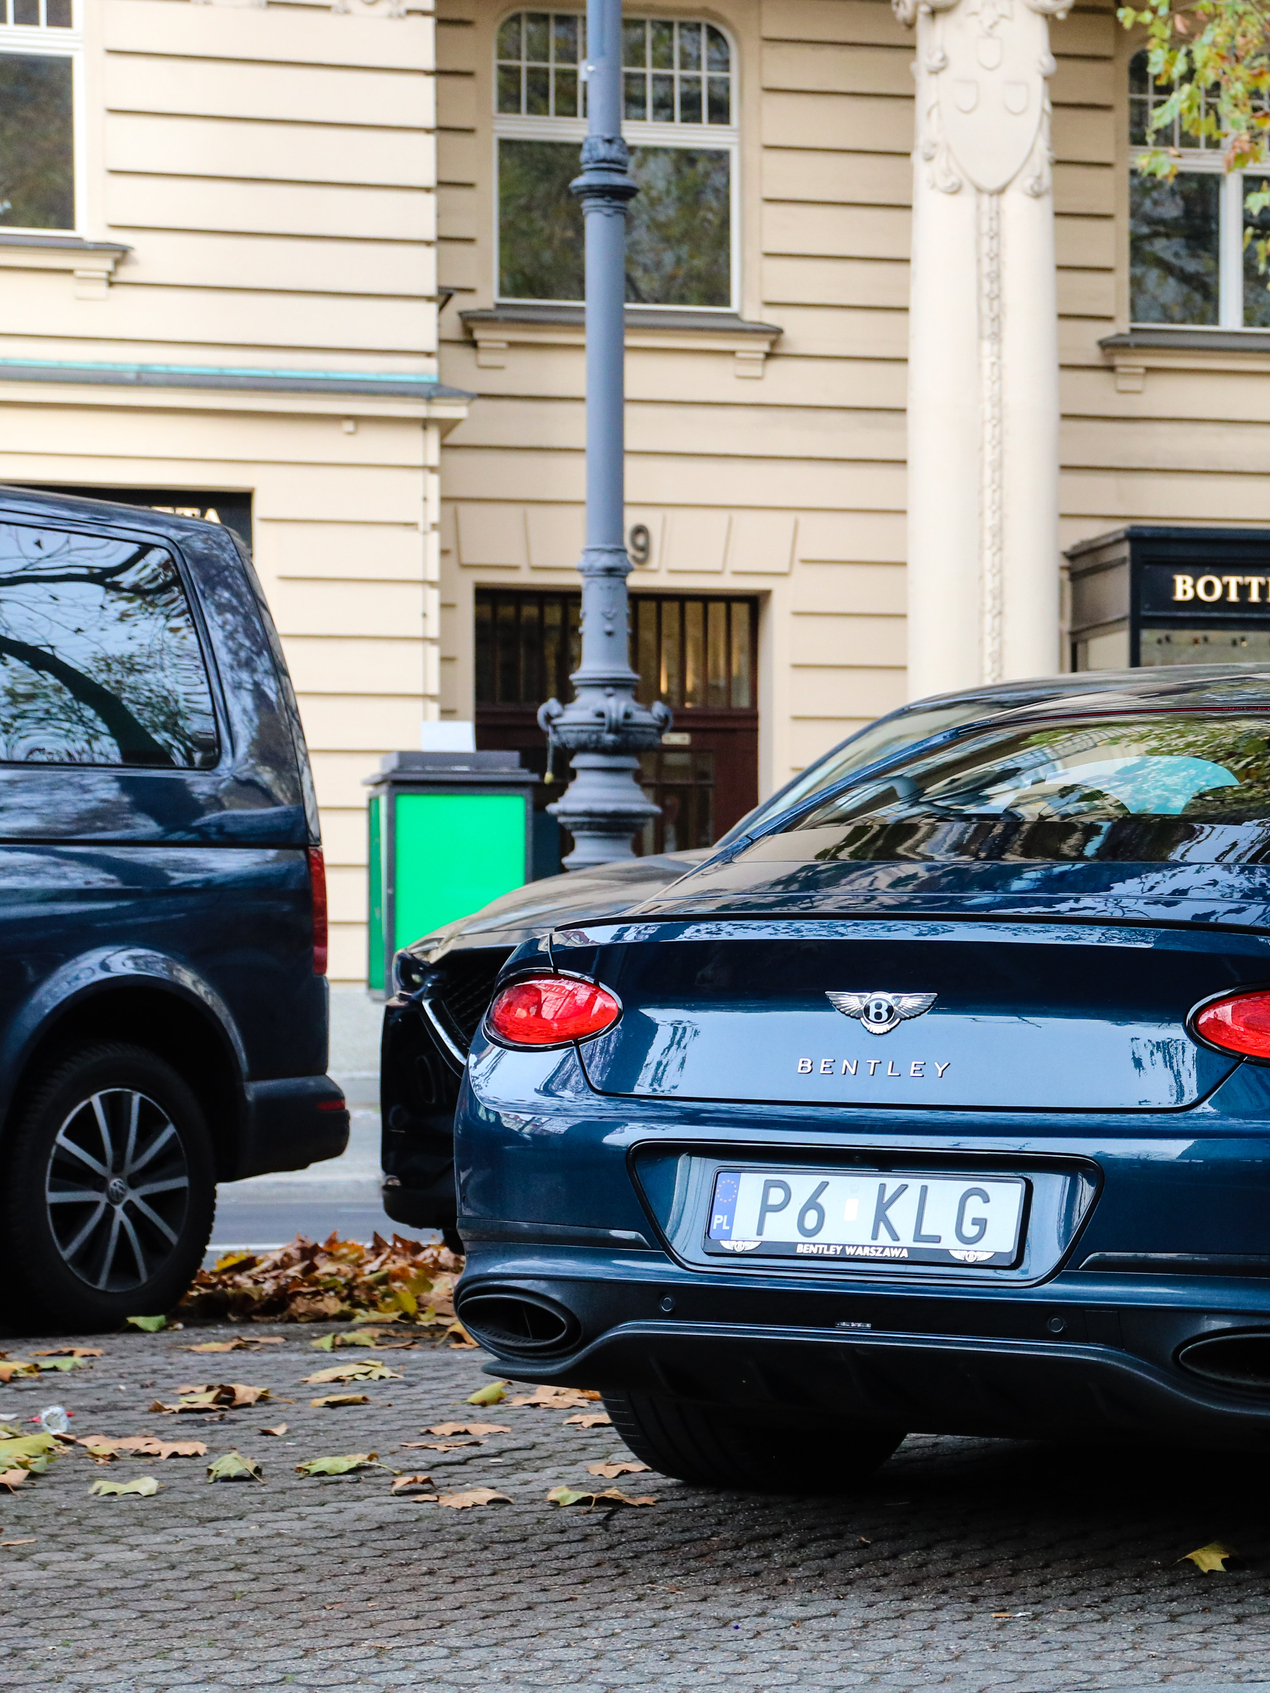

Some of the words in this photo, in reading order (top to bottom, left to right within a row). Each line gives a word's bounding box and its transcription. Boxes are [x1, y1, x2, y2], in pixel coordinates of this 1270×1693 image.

[630, 524, 650, 566] 9
[796, 1057, 951, 1078] BENTLEY
[712, 1214, 731, 1230] PL
[756, 1179, 830, 1238] P6
[870, 1183, 991, 1245] KLG
[796, 1243, 844, 1255] BENTLEY
[845, 1246, 909, 1258] WARSZAWA
